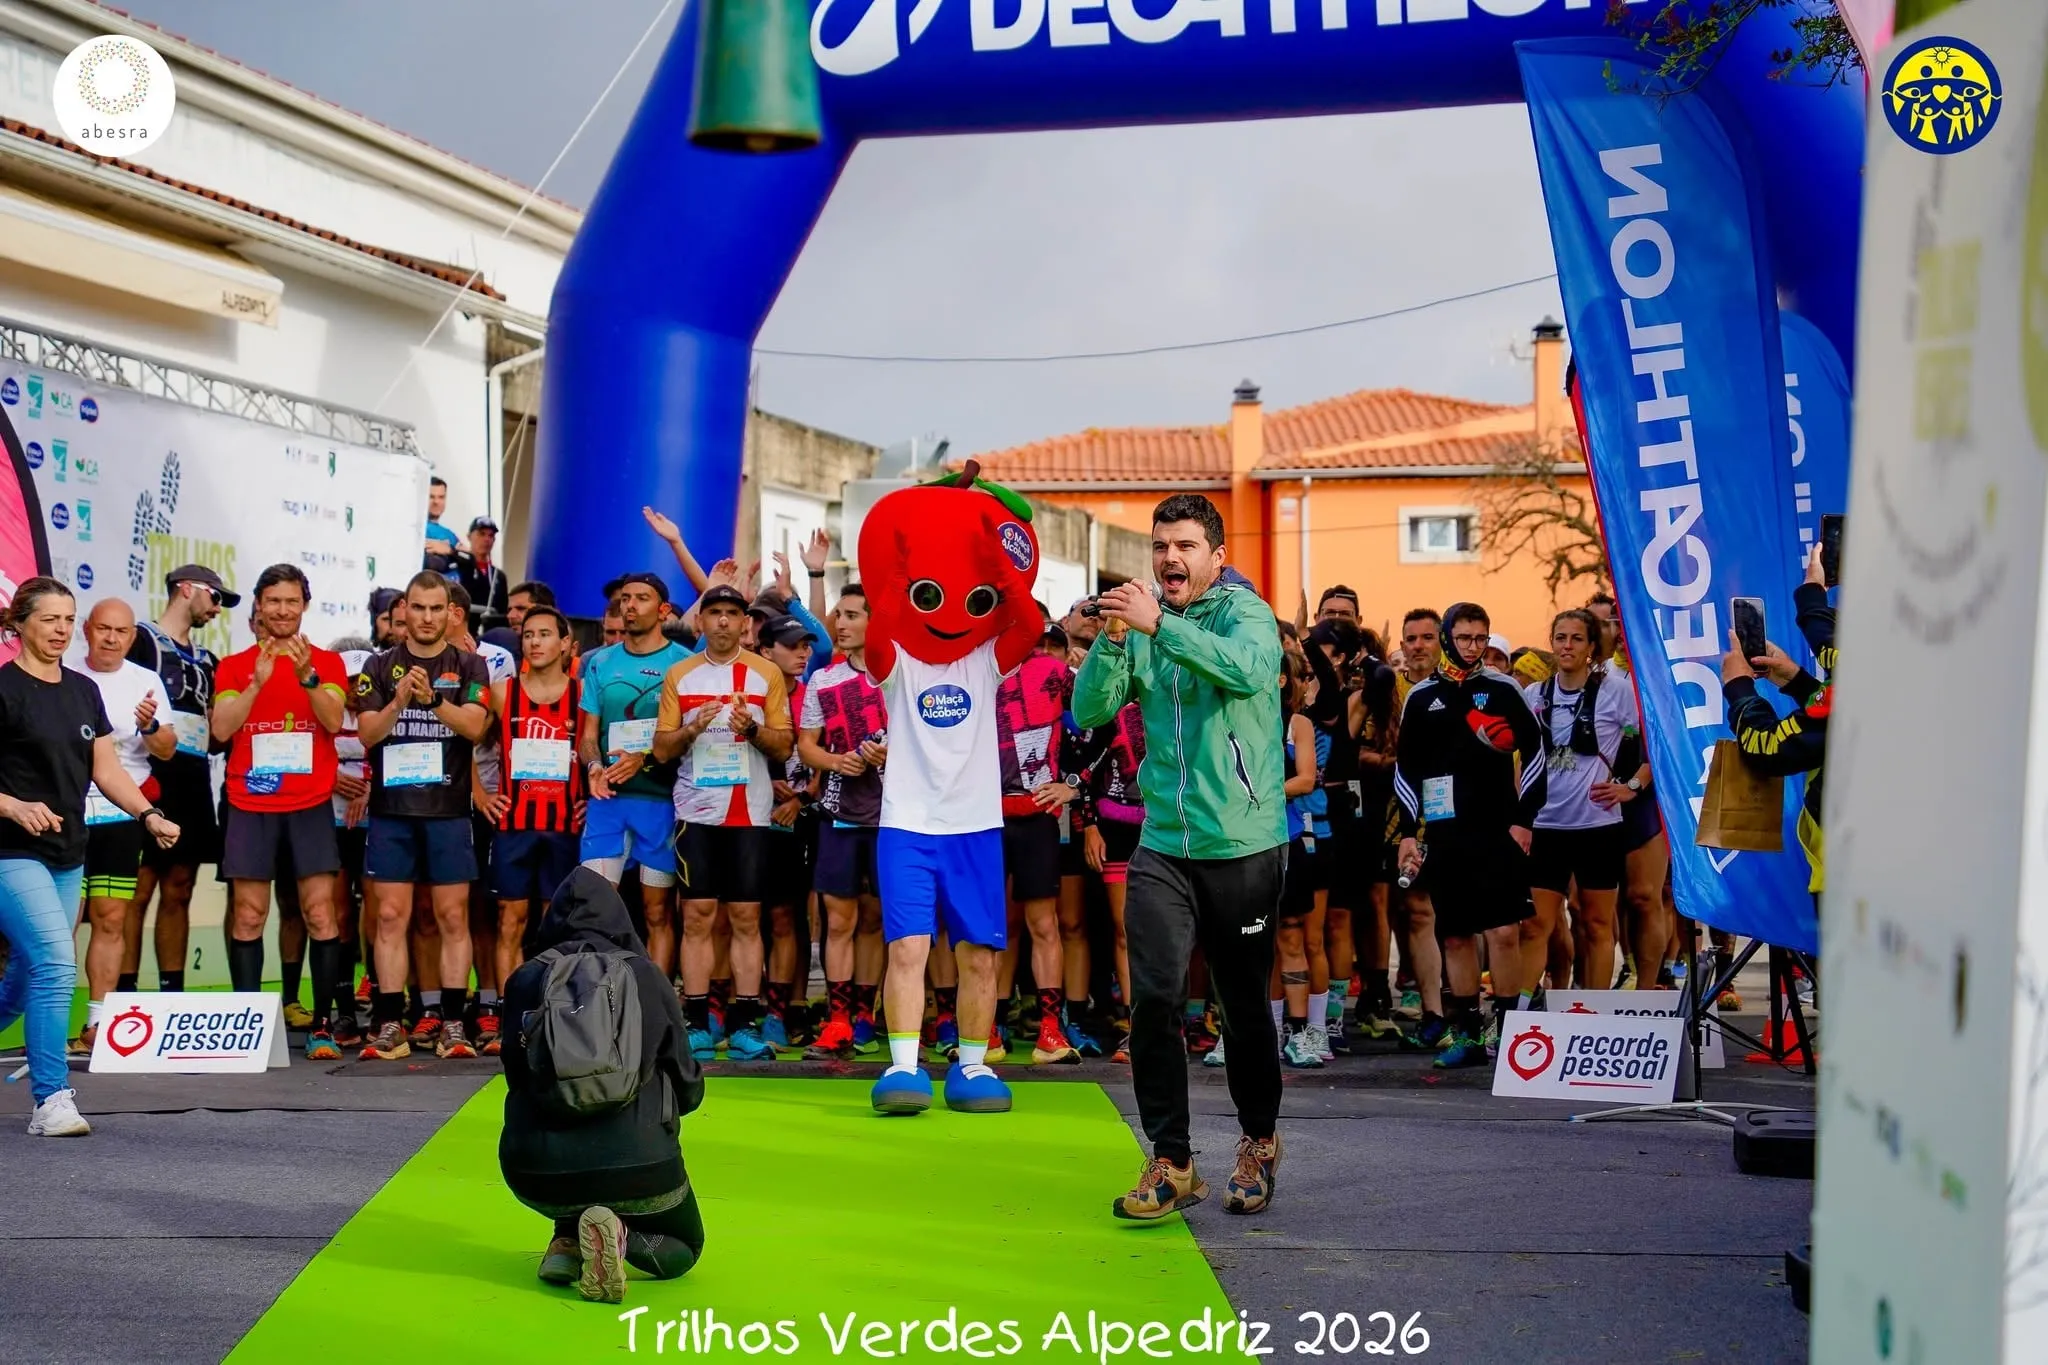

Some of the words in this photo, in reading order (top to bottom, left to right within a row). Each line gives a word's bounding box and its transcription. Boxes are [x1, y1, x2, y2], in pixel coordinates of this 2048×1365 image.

[1002, 538, 1029, 566] Alcobaça
[936, 694, 963, 706] Maçã
[399, 708, 427, 719] LÉTICO
[923, 707, 967, 718] Alcobaça
[408, 721, 456, 737] MAMED
[1241, 923, 1263, 935] PUMA
[193, 947, 202, 970] 2
[165, 1007, 263, 1031] recorde
[156, 1027, 265, 1057] pessoal
[1566, 1032, 1668, 1058] recorde
[1558, 1054, 1669, 1082] pessoal
